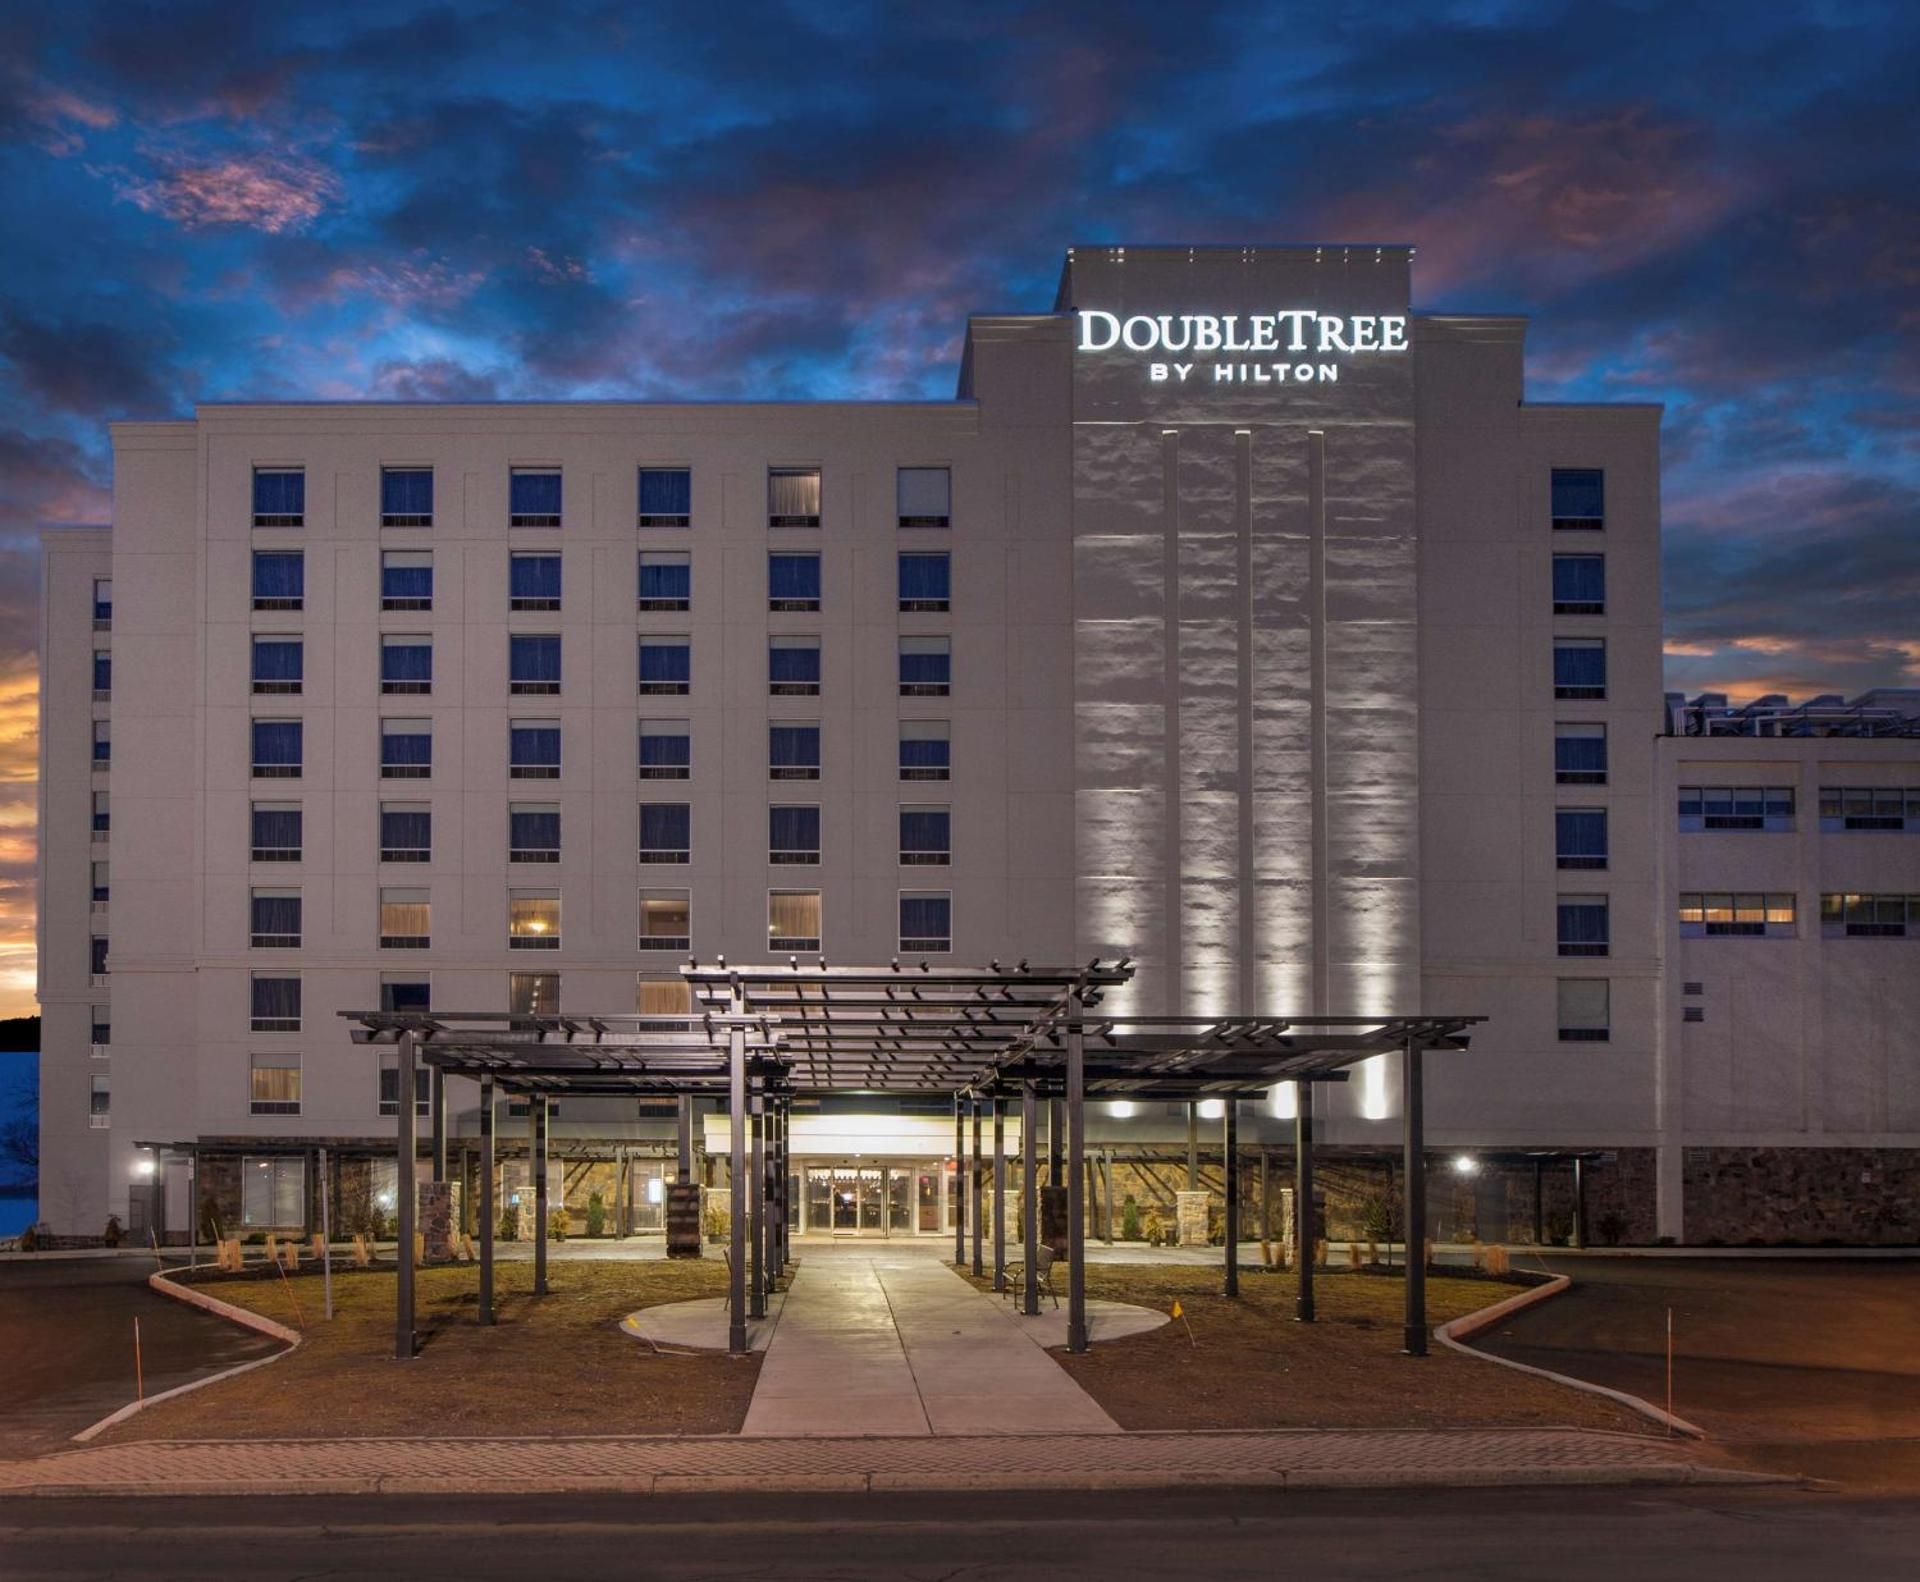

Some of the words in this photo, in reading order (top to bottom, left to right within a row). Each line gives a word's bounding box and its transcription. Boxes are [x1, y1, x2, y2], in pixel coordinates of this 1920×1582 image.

[1076, 309, 1410, 352] DOUBLETREE
[1150, 362, 1194, 382] BY
[1214, 362, 1339, 382] HILTON
